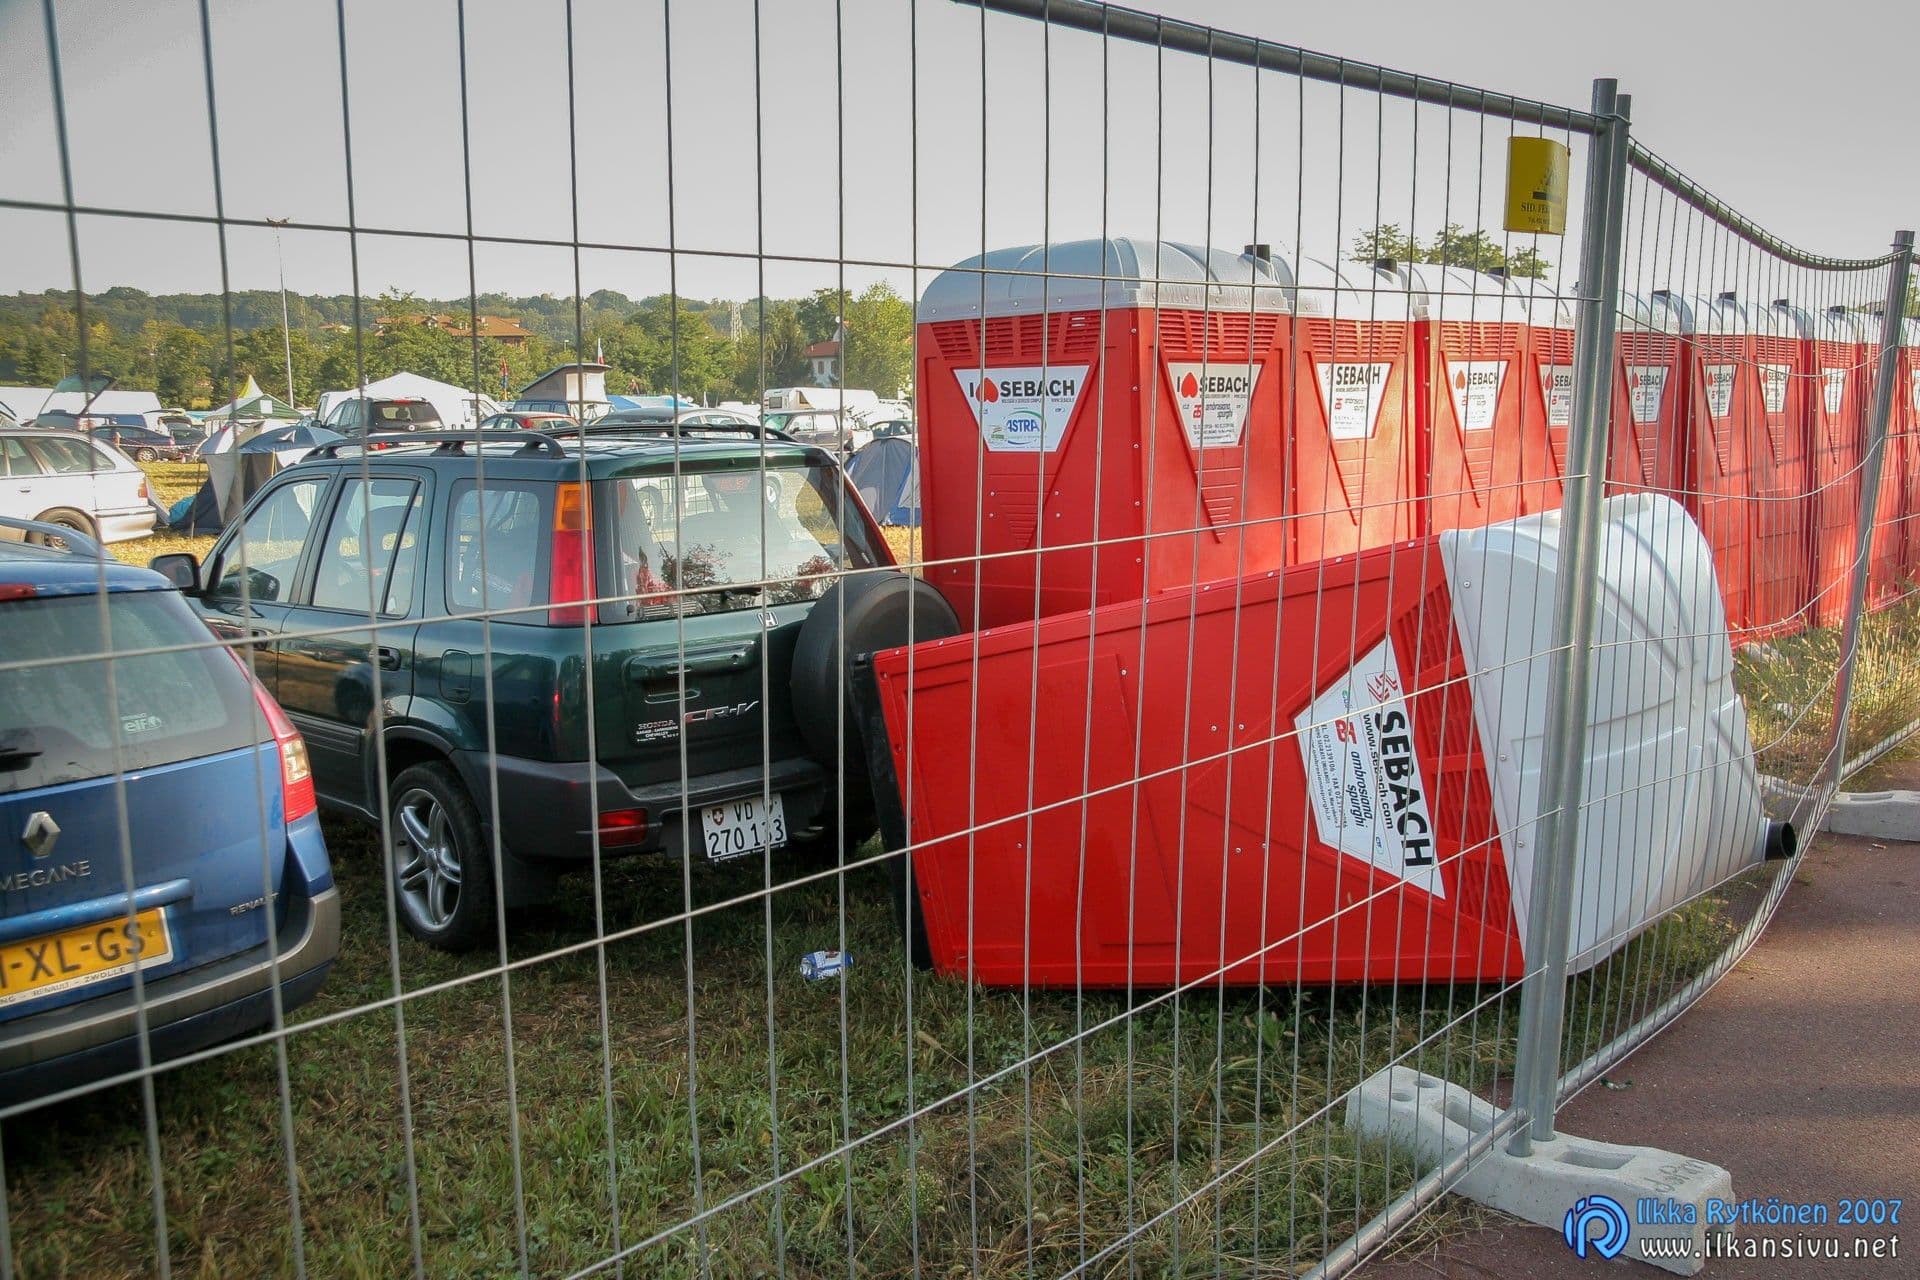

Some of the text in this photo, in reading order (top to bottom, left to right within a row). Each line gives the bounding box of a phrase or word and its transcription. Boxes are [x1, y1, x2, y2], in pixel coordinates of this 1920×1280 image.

[1000, 379, 1075, 398] SEBACH
[1199, 376, 1249, 393] SEBACH
[1336, 366, 1381, 385] SEBACH
[1006, 419, 1040, 433] ASTRA
[1351, 751, 1373, 819] ambrosiana
[1363, 713, 1394, 829] www.sebach.com
[1375, 711, 1432, 866] SEBACH
[734, 802, 753, 822] VD
[1346, 784, 1368, 827] spurghi
[709, 827, 745, 856] 270
[0, 860, 91, 892] MEGANE
